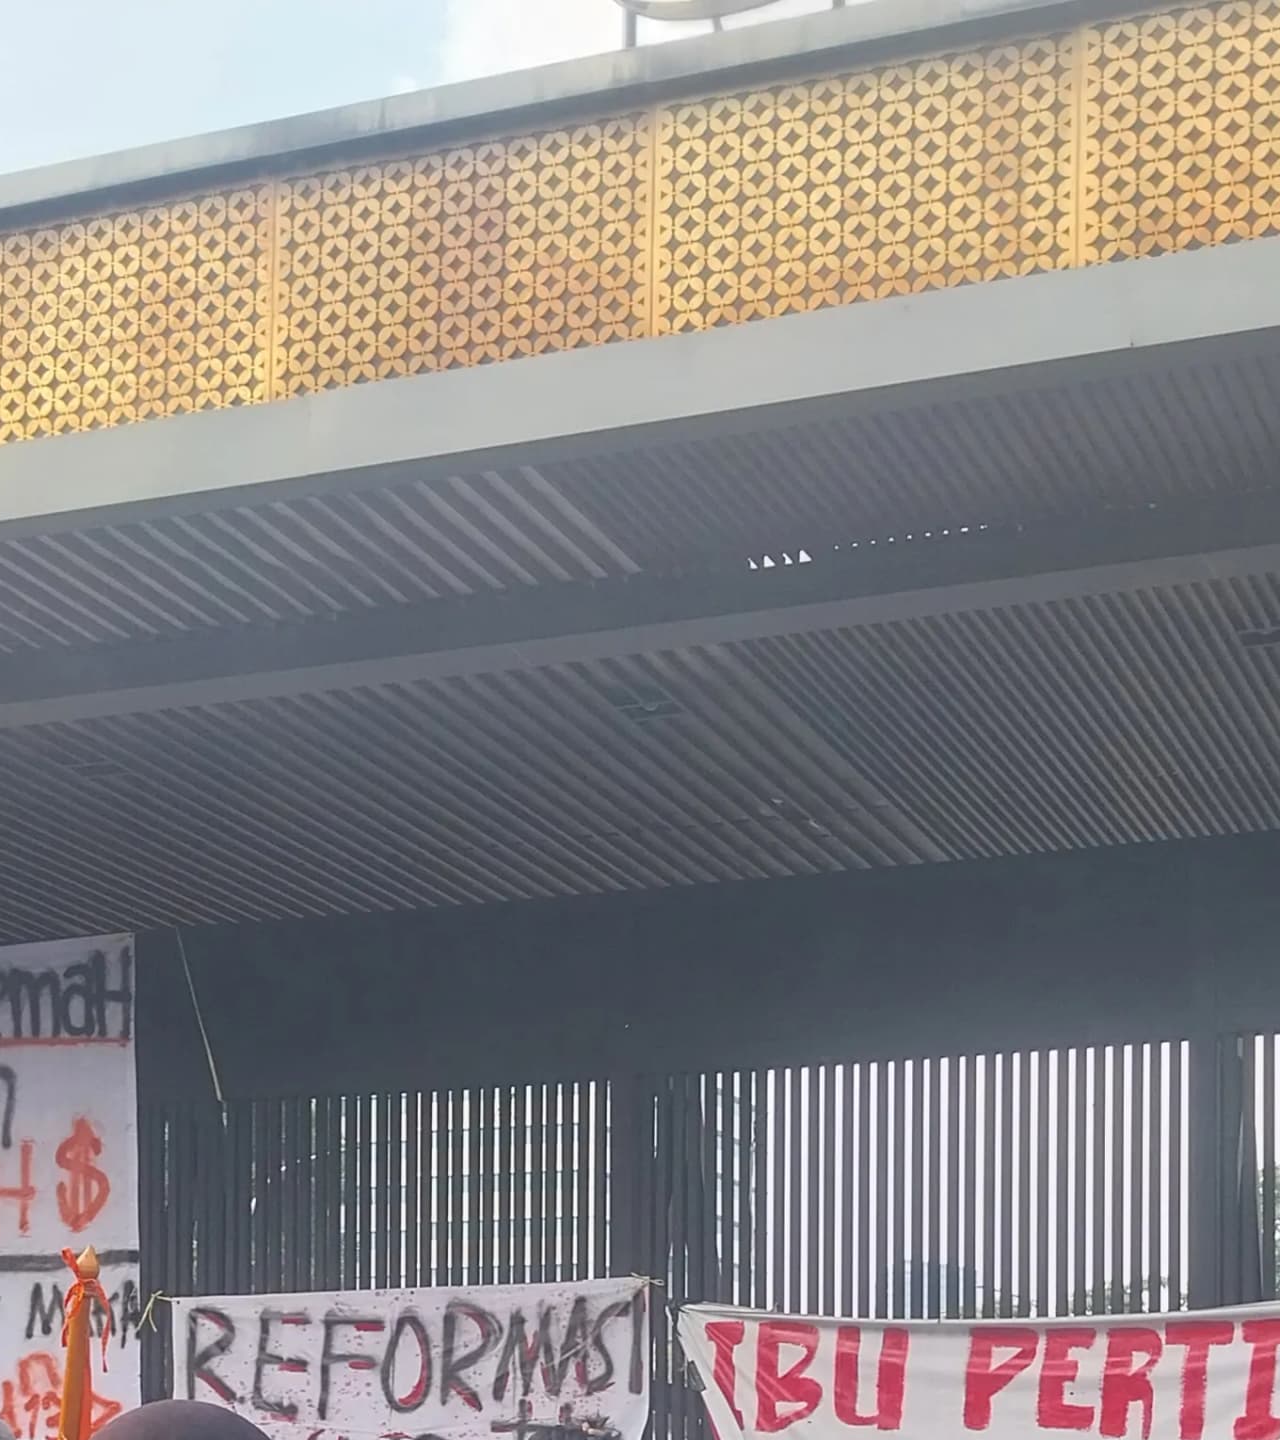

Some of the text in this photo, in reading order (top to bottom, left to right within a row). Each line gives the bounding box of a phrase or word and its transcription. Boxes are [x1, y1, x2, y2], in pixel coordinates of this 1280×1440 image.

[23, 1278, 141, 1350] MKA
[185, 1288, 644, 1422] REFORMASI
[704, 1321, 910, 1433] IBU
